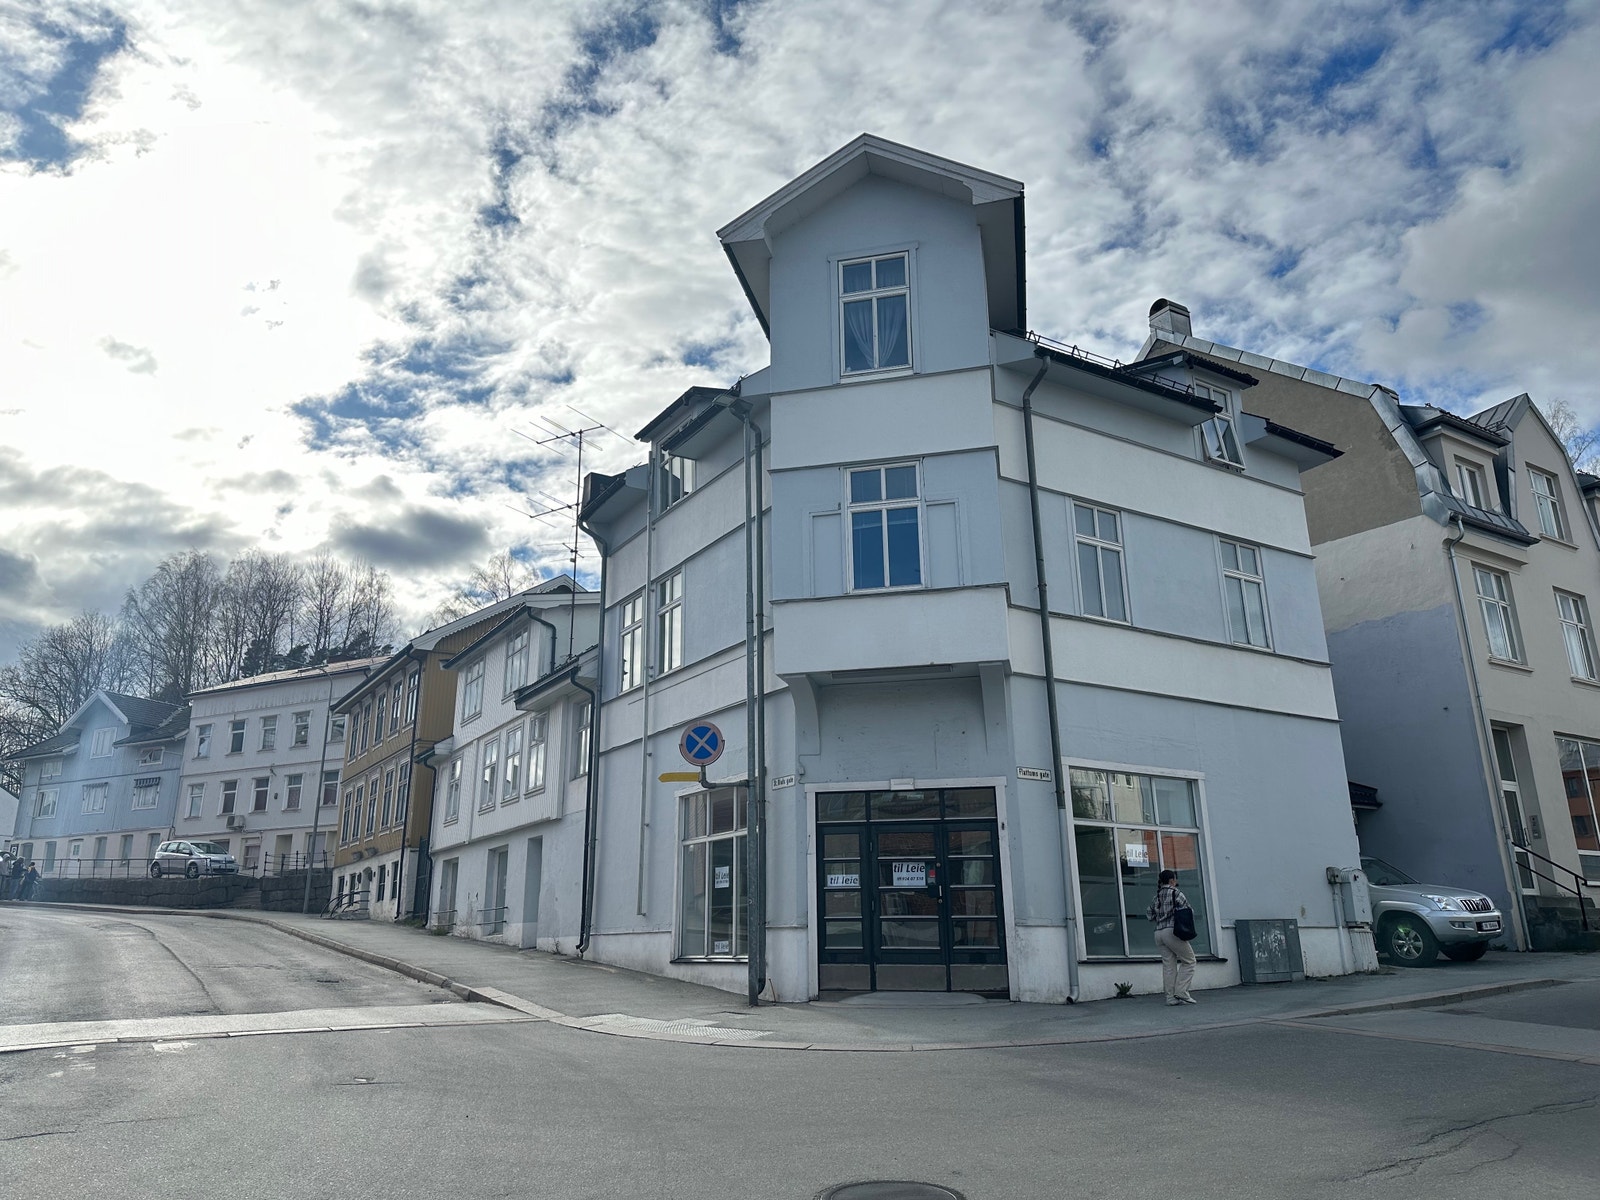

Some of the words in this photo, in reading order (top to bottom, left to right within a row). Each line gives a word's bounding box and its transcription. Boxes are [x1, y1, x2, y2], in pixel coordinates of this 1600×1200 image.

[894, 864, 903, 873] til
[906, 864, 925, 873] Leie
[830, 877, 839, 885] til
[841, 876, 859, 885] leie
